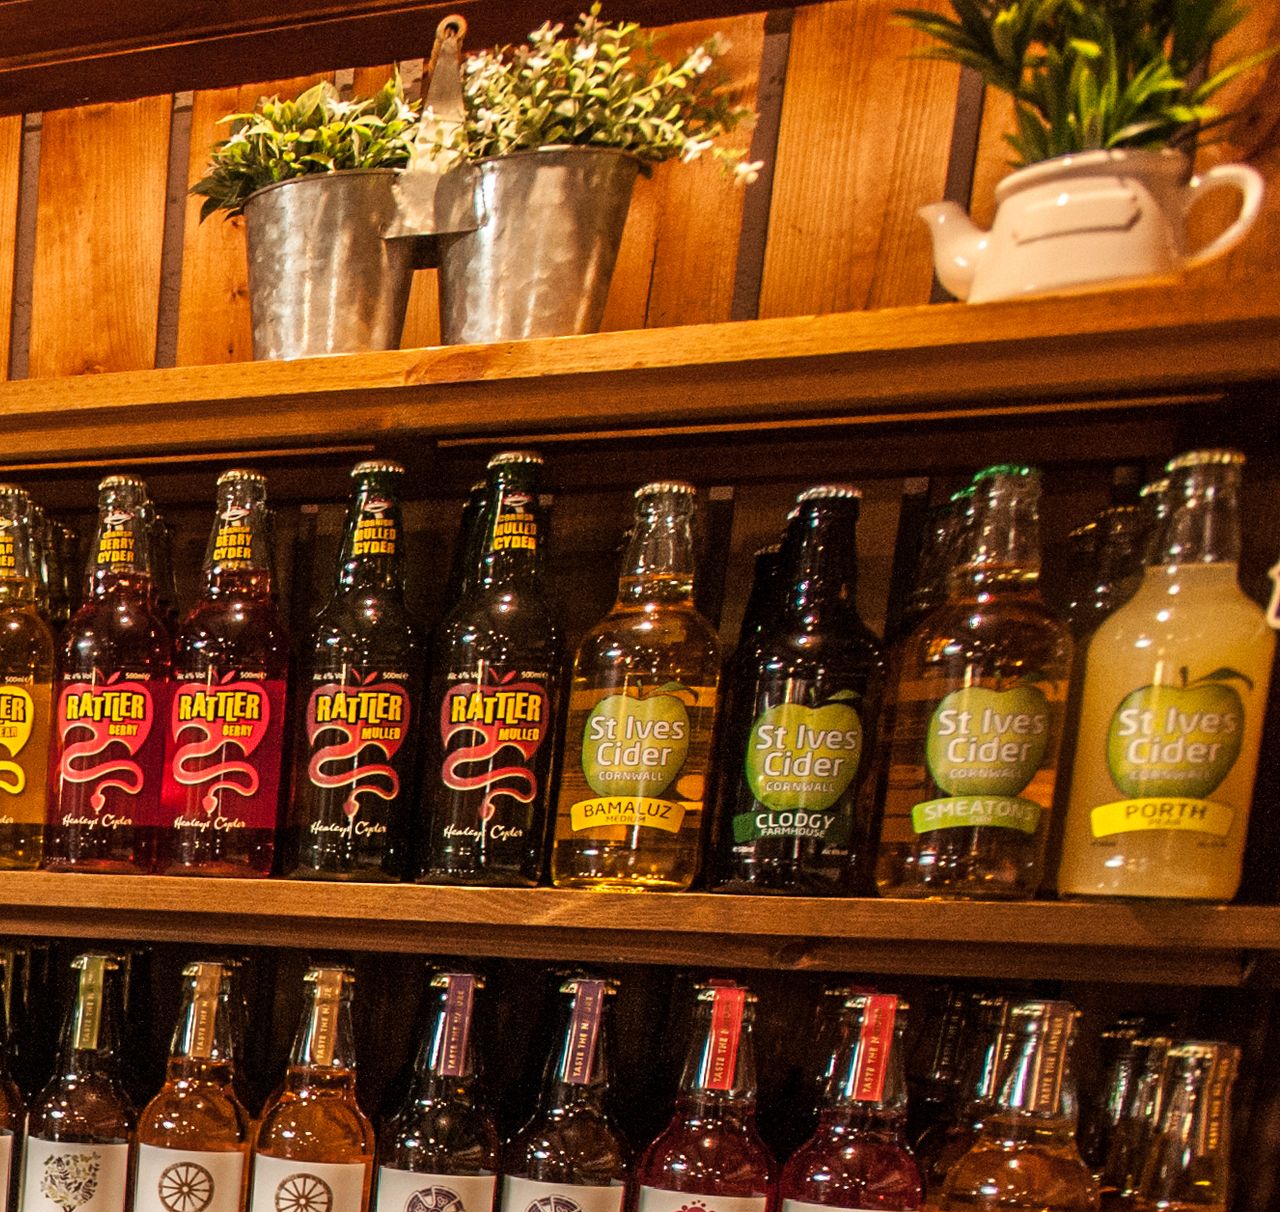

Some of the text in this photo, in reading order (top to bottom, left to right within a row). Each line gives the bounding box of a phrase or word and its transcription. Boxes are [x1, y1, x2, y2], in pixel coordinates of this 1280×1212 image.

[494, 523, 536, 536] MULLED
[99, 539, 134, 551] BERRY
[216, 533, 252, 546] BERRY
[494, 536, 536, 549] CYDER
[98, 551, 134, 562] CYDER
[213, 546, 251, 559] CYDER
[66, 692, 144, 721] RATTLER
[179, 692, 259, 721] RATTLER
[317, 692, 402, 724] RATTLER
[452, 692, 542, 724] RATTLER
[590, 716, 685, 740] St Ives
[938, 710, 1045, 735] St Ives
[1118, 708, 1237, 735] St Ives
[108, 724, 138, 736] BERRY
[222, 724, 252, 737] BERRY
[361, 727, 401, 741] MULLED
[498, 728, 539, 741] MULLED
[756, 726, 857, 750] St Ives
[596, 744, 671, 766] Cider
[948, 738, 1031, 763] Cider
[1127, 738, 1221, 764] Cider
[763, 753, 843, 776] Cider
[598, 771, 663, 781] CORNWALL
[765, 782, 835, 792] CORNWALL
[584, 801, 671, 818] BAMALUZ
[1125, 804, 1207, 819] PORTH
[99, 814, 132, 826] Cyder
[214, 816, 246, 829] Cyder
[756, 814, 834, 830] CLODGY
[761, 827, 826, 838] FARMHOUSE
